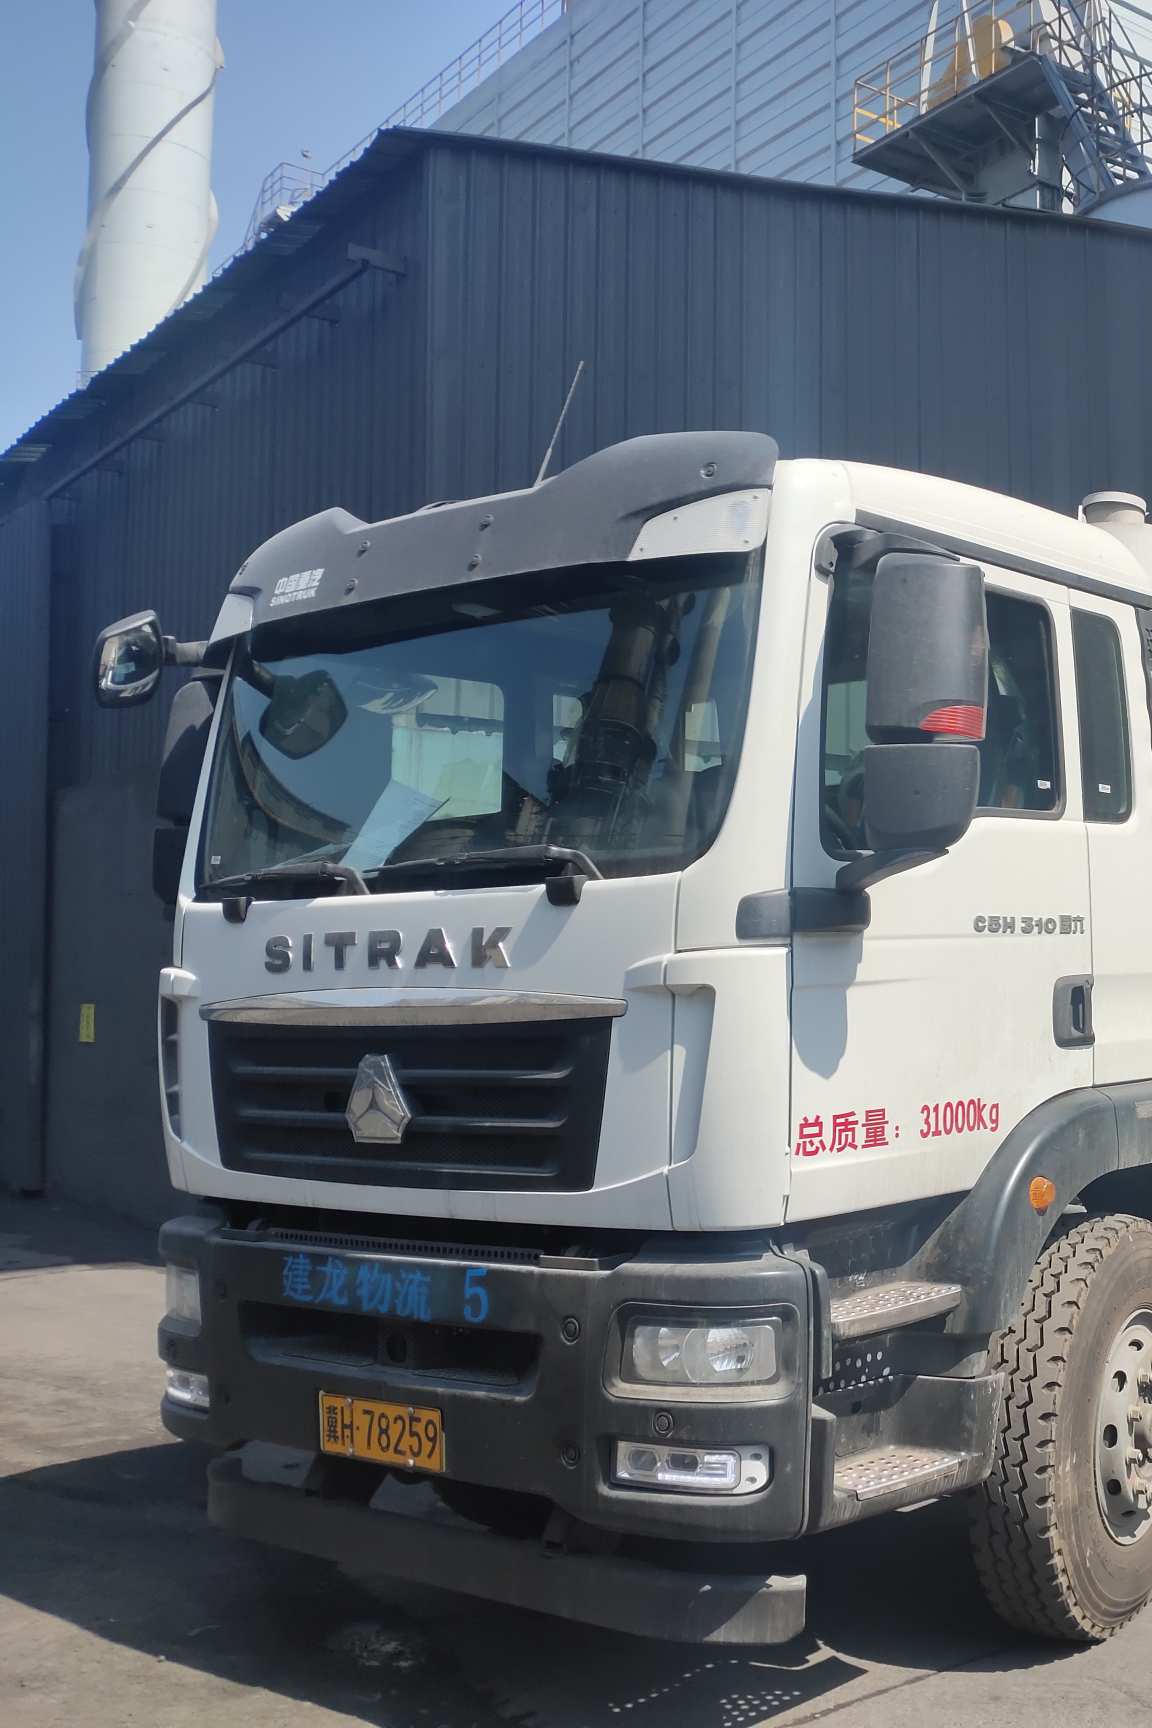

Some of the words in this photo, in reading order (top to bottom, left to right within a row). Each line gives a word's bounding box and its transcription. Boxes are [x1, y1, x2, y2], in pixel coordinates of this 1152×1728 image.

[1020, 916, 1057, 935] 310
[264, 926, 513, 974] SITRAK
[919, 1098, 1000, 1139] 31000kg
[282, 1253, 432, 1322] 建龙物流
[463, 1267, 489, 1324] 5
